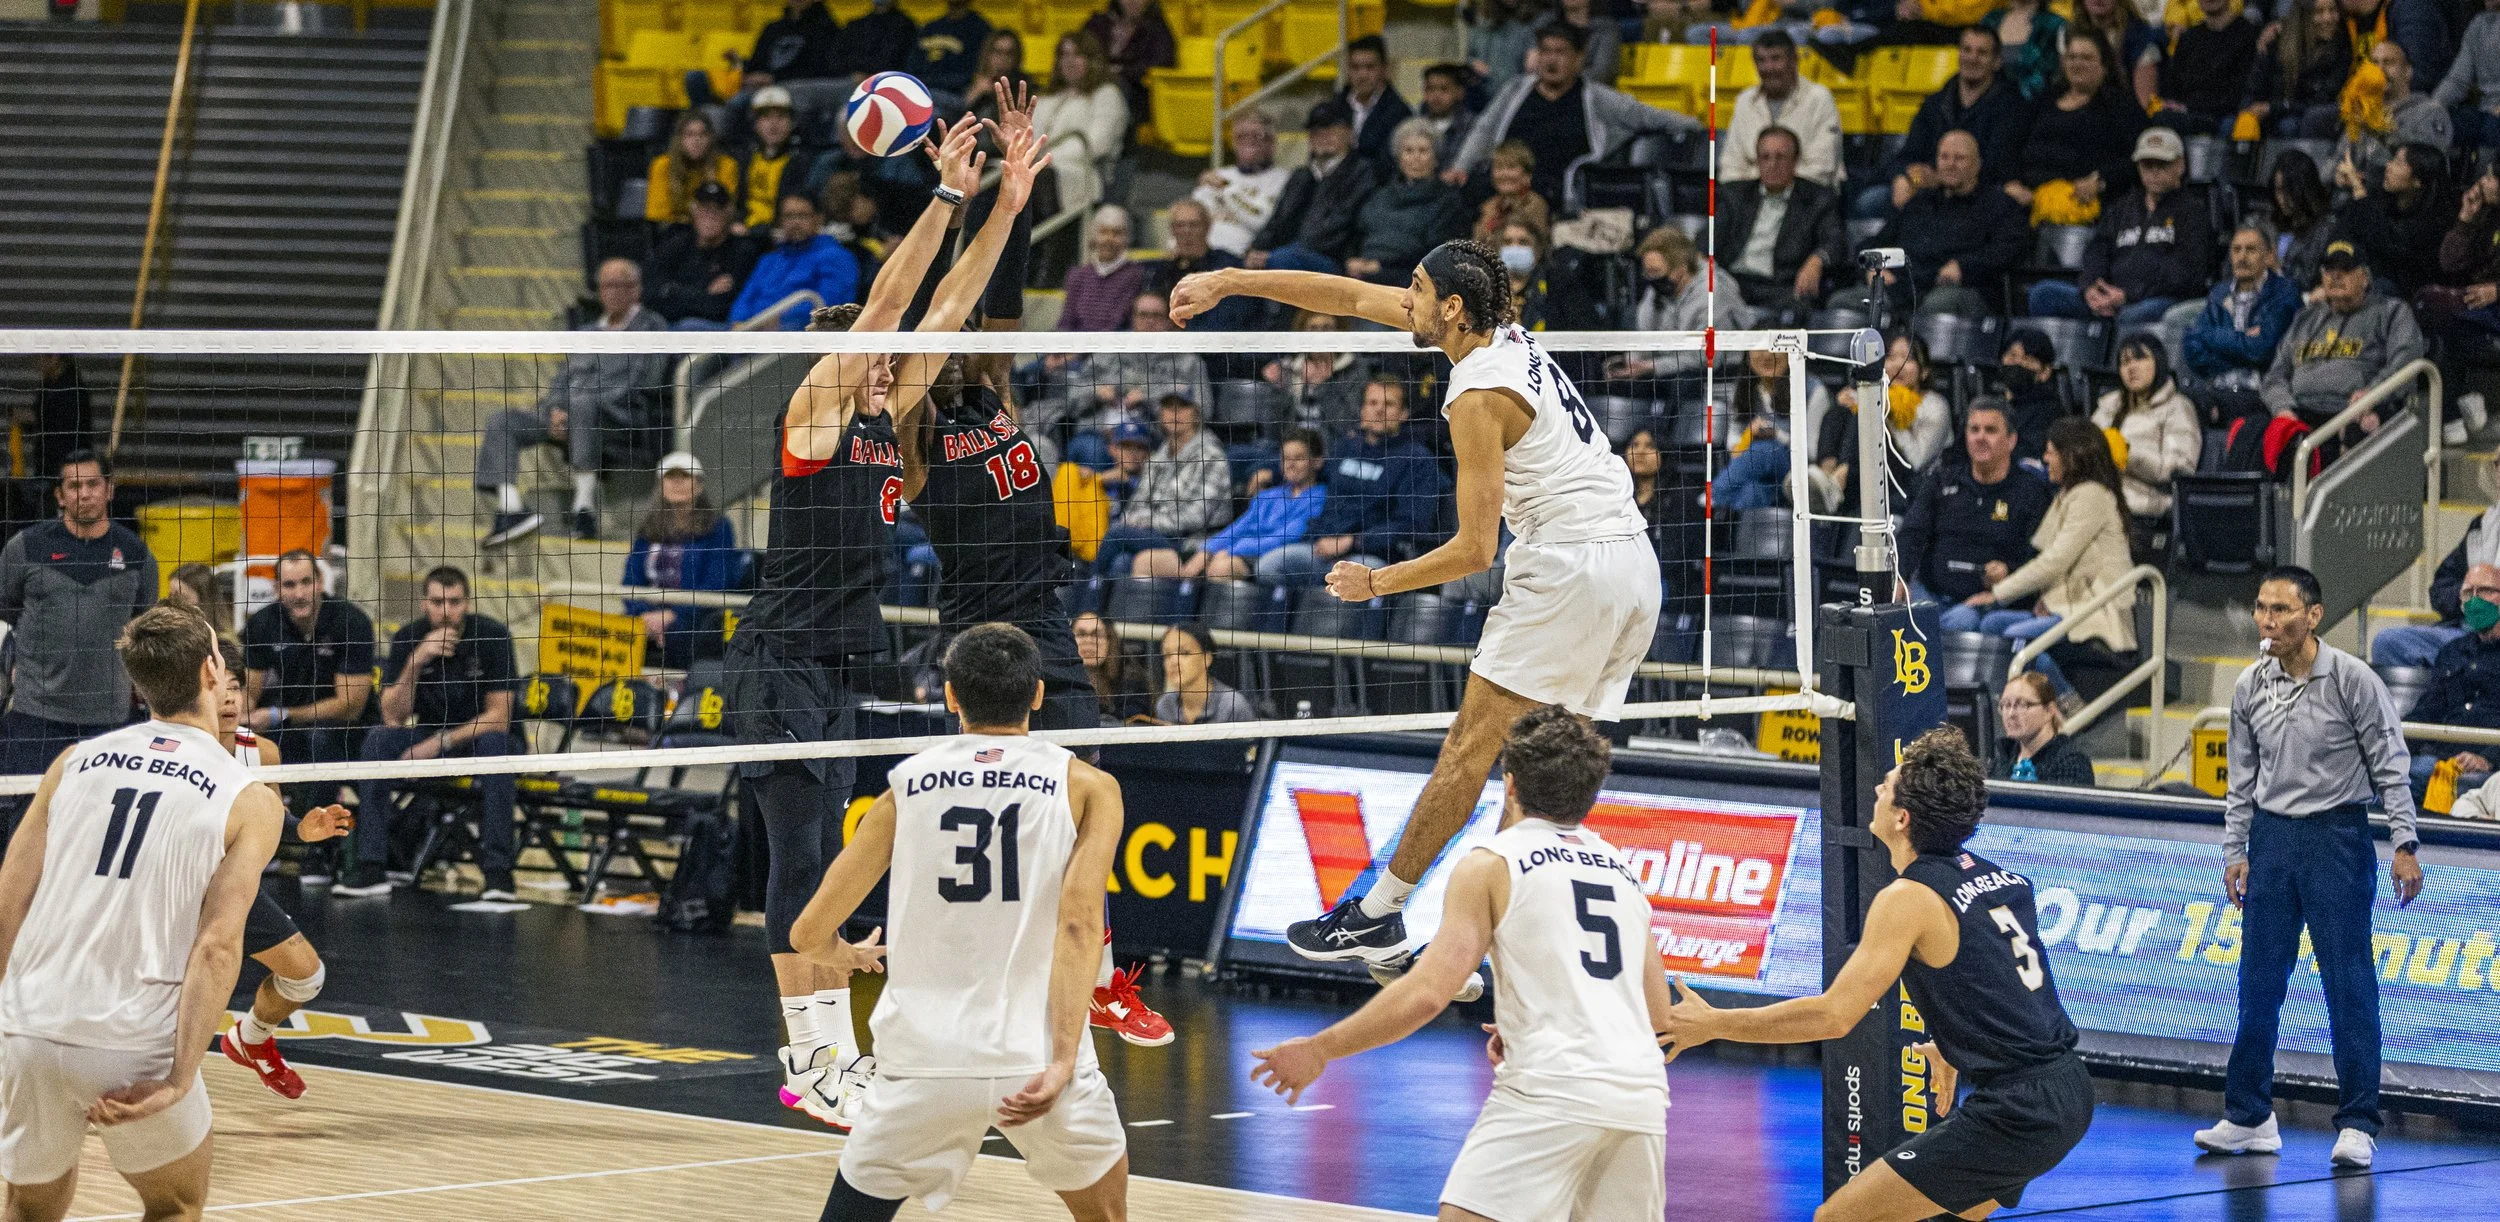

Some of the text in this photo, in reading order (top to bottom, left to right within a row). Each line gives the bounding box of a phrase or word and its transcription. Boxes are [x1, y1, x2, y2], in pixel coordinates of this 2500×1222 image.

[1547, 363, 1594, 444] 8
[850, 435, 898, 468] BALL
[943, 427, 998, 462] BALL
[985, 440, 1041, 500] 18
[1859, 587, 1873, 606] S
[1891, 628, 1931, 698] LB
[79, 752, 217, 800] LONG BEACH
[907, 770, 1057, 797] LONG BEACH
[95, 787, 163, 879] 11
[938, 803, 1022, 903] 31
[1518, 846, 1575, 875] LONG
[1570, 879, 1624, 981] 5
[1988, 904, 2044, 992] 3
[2036, 886, 2164, 958] Our
[381, 1048, 659, 1084] WEST
[454, 1043, 662, 1069] BIG
[550, 1036, 755, 1064] THE
[1901, 1045, 1928, 1133] ONG
